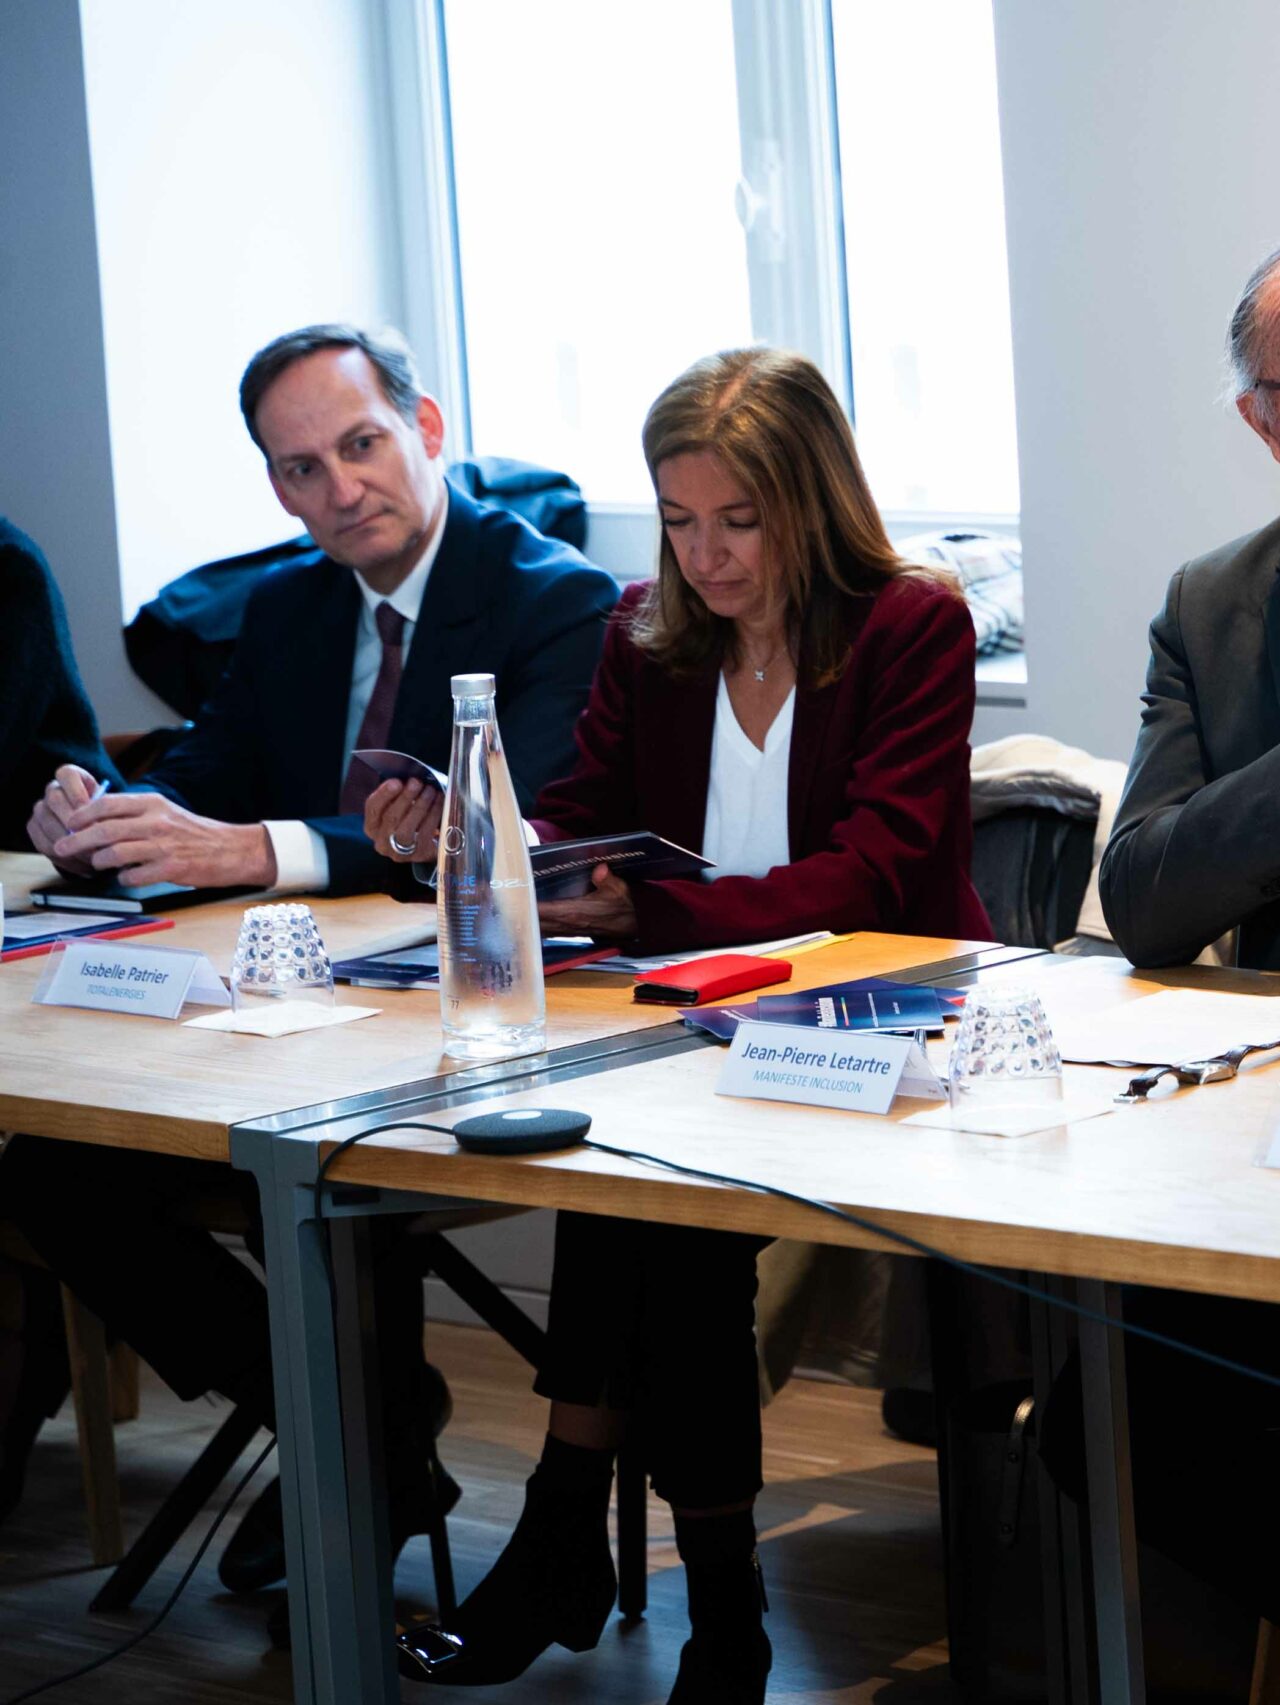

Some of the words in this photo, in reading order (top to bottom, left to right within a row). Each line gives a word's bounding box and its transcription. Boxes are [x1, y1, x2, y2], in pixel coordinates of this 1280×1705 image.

[81, 962, 126, 980] Isabelle
[127, 966, 169, 984] Patrier
[741, 1043, 826, 1067] Jean-Pierre
[830, 1052, 891, 1075] Letartre
[753, 1070, 808, 1087] MANIFESTE
[809, 1077, 863, 1093] INCLUSION
